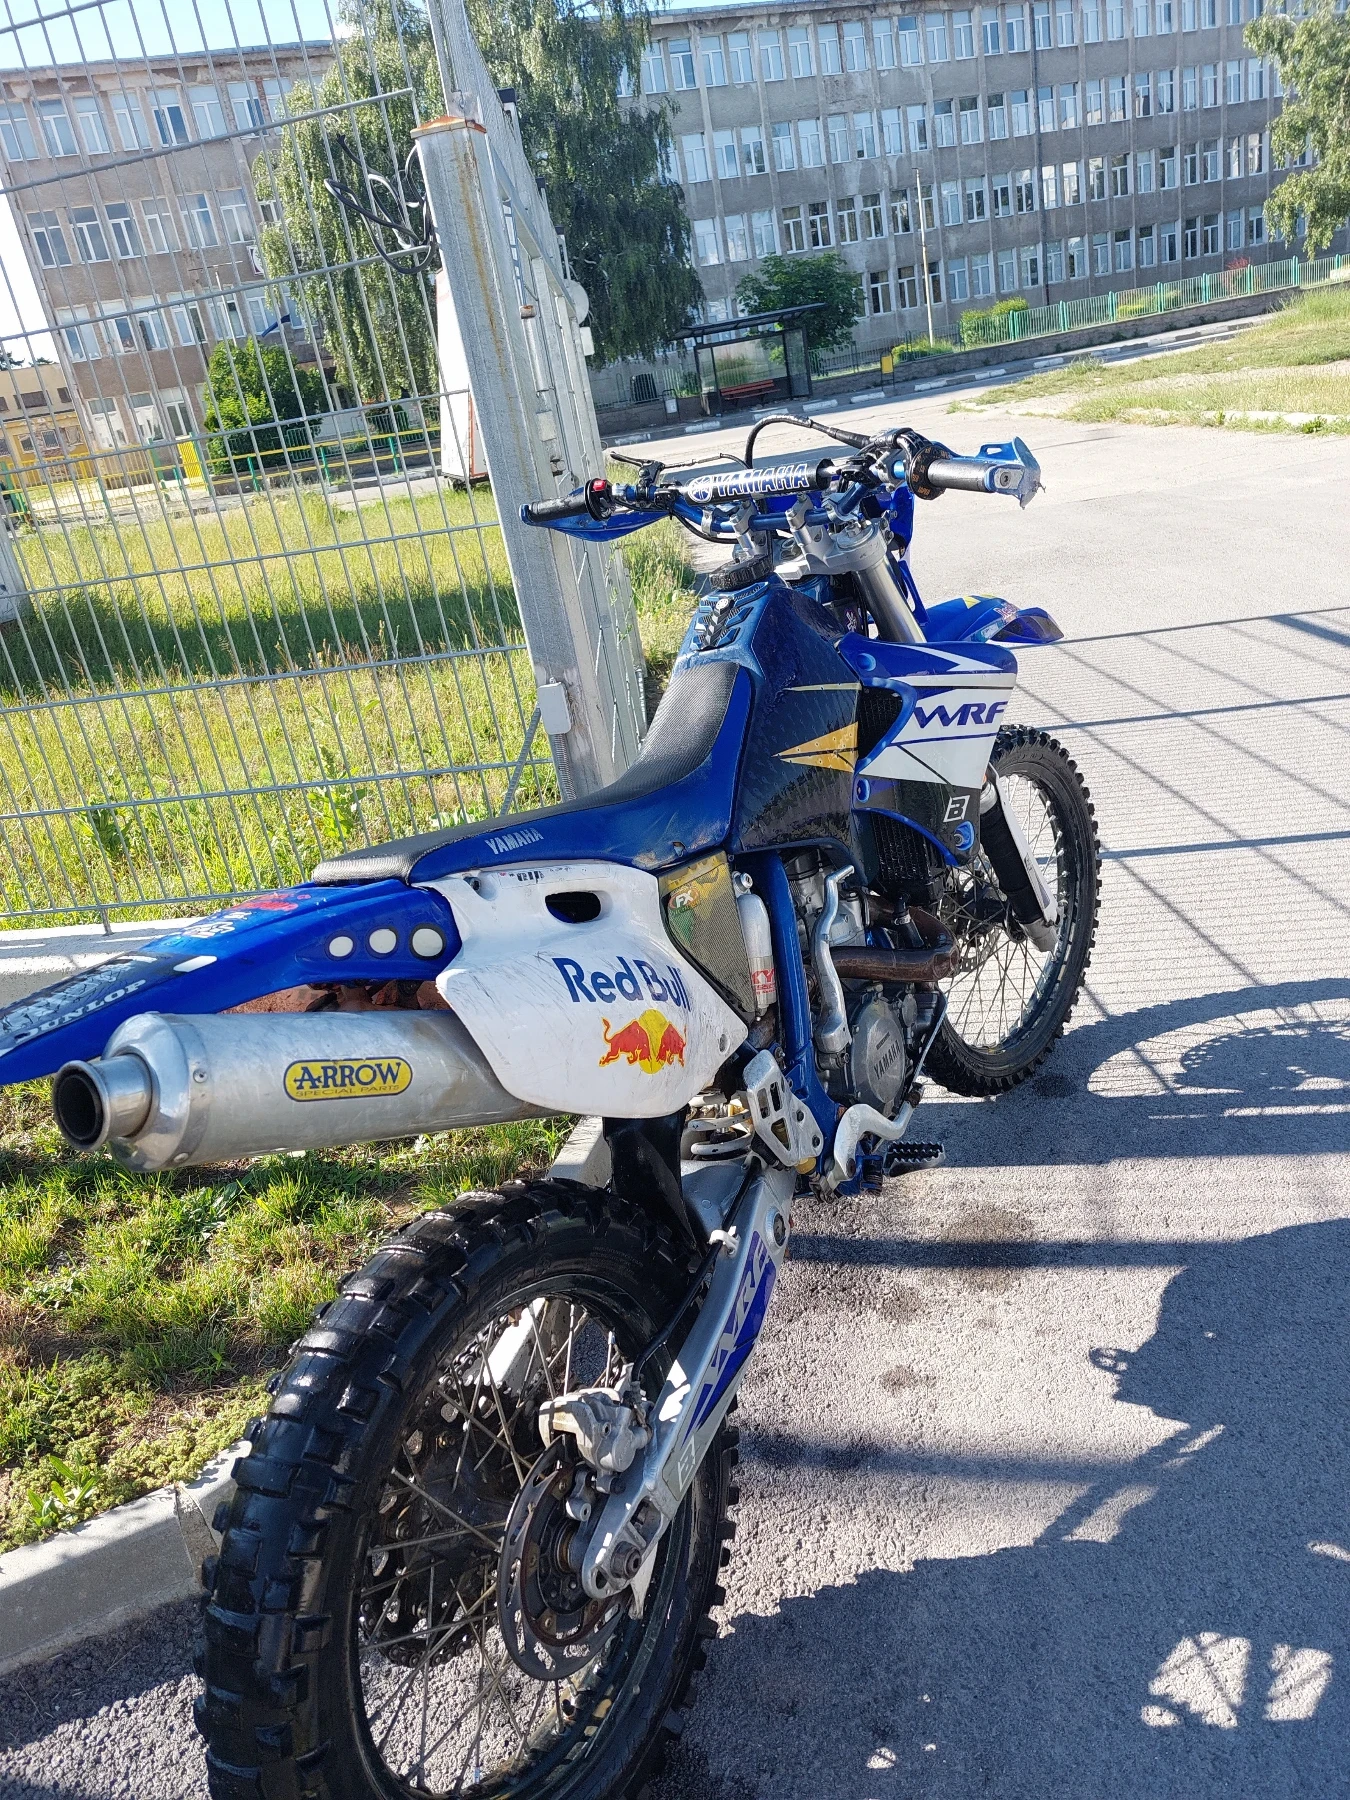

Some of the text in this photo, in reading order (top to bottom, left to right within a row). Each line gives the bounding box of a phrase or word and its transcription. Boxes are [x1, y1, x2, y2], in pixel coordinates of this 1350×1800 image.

[714, 463, 810, 498] YAMAHA
[913, 701, 1008, 729] WRF
[485, 828, 544, 854] YAMAHA
[552, 956, 691, 1012] Red Bull
[17, 979, 146, 1044] DUNLOP
[874, 1040, 900, 1080] YAMAHA
[294, 1062, 401, 1090] ARROW
[296, 1085, 400, 1098] SPECIAL PARTS
